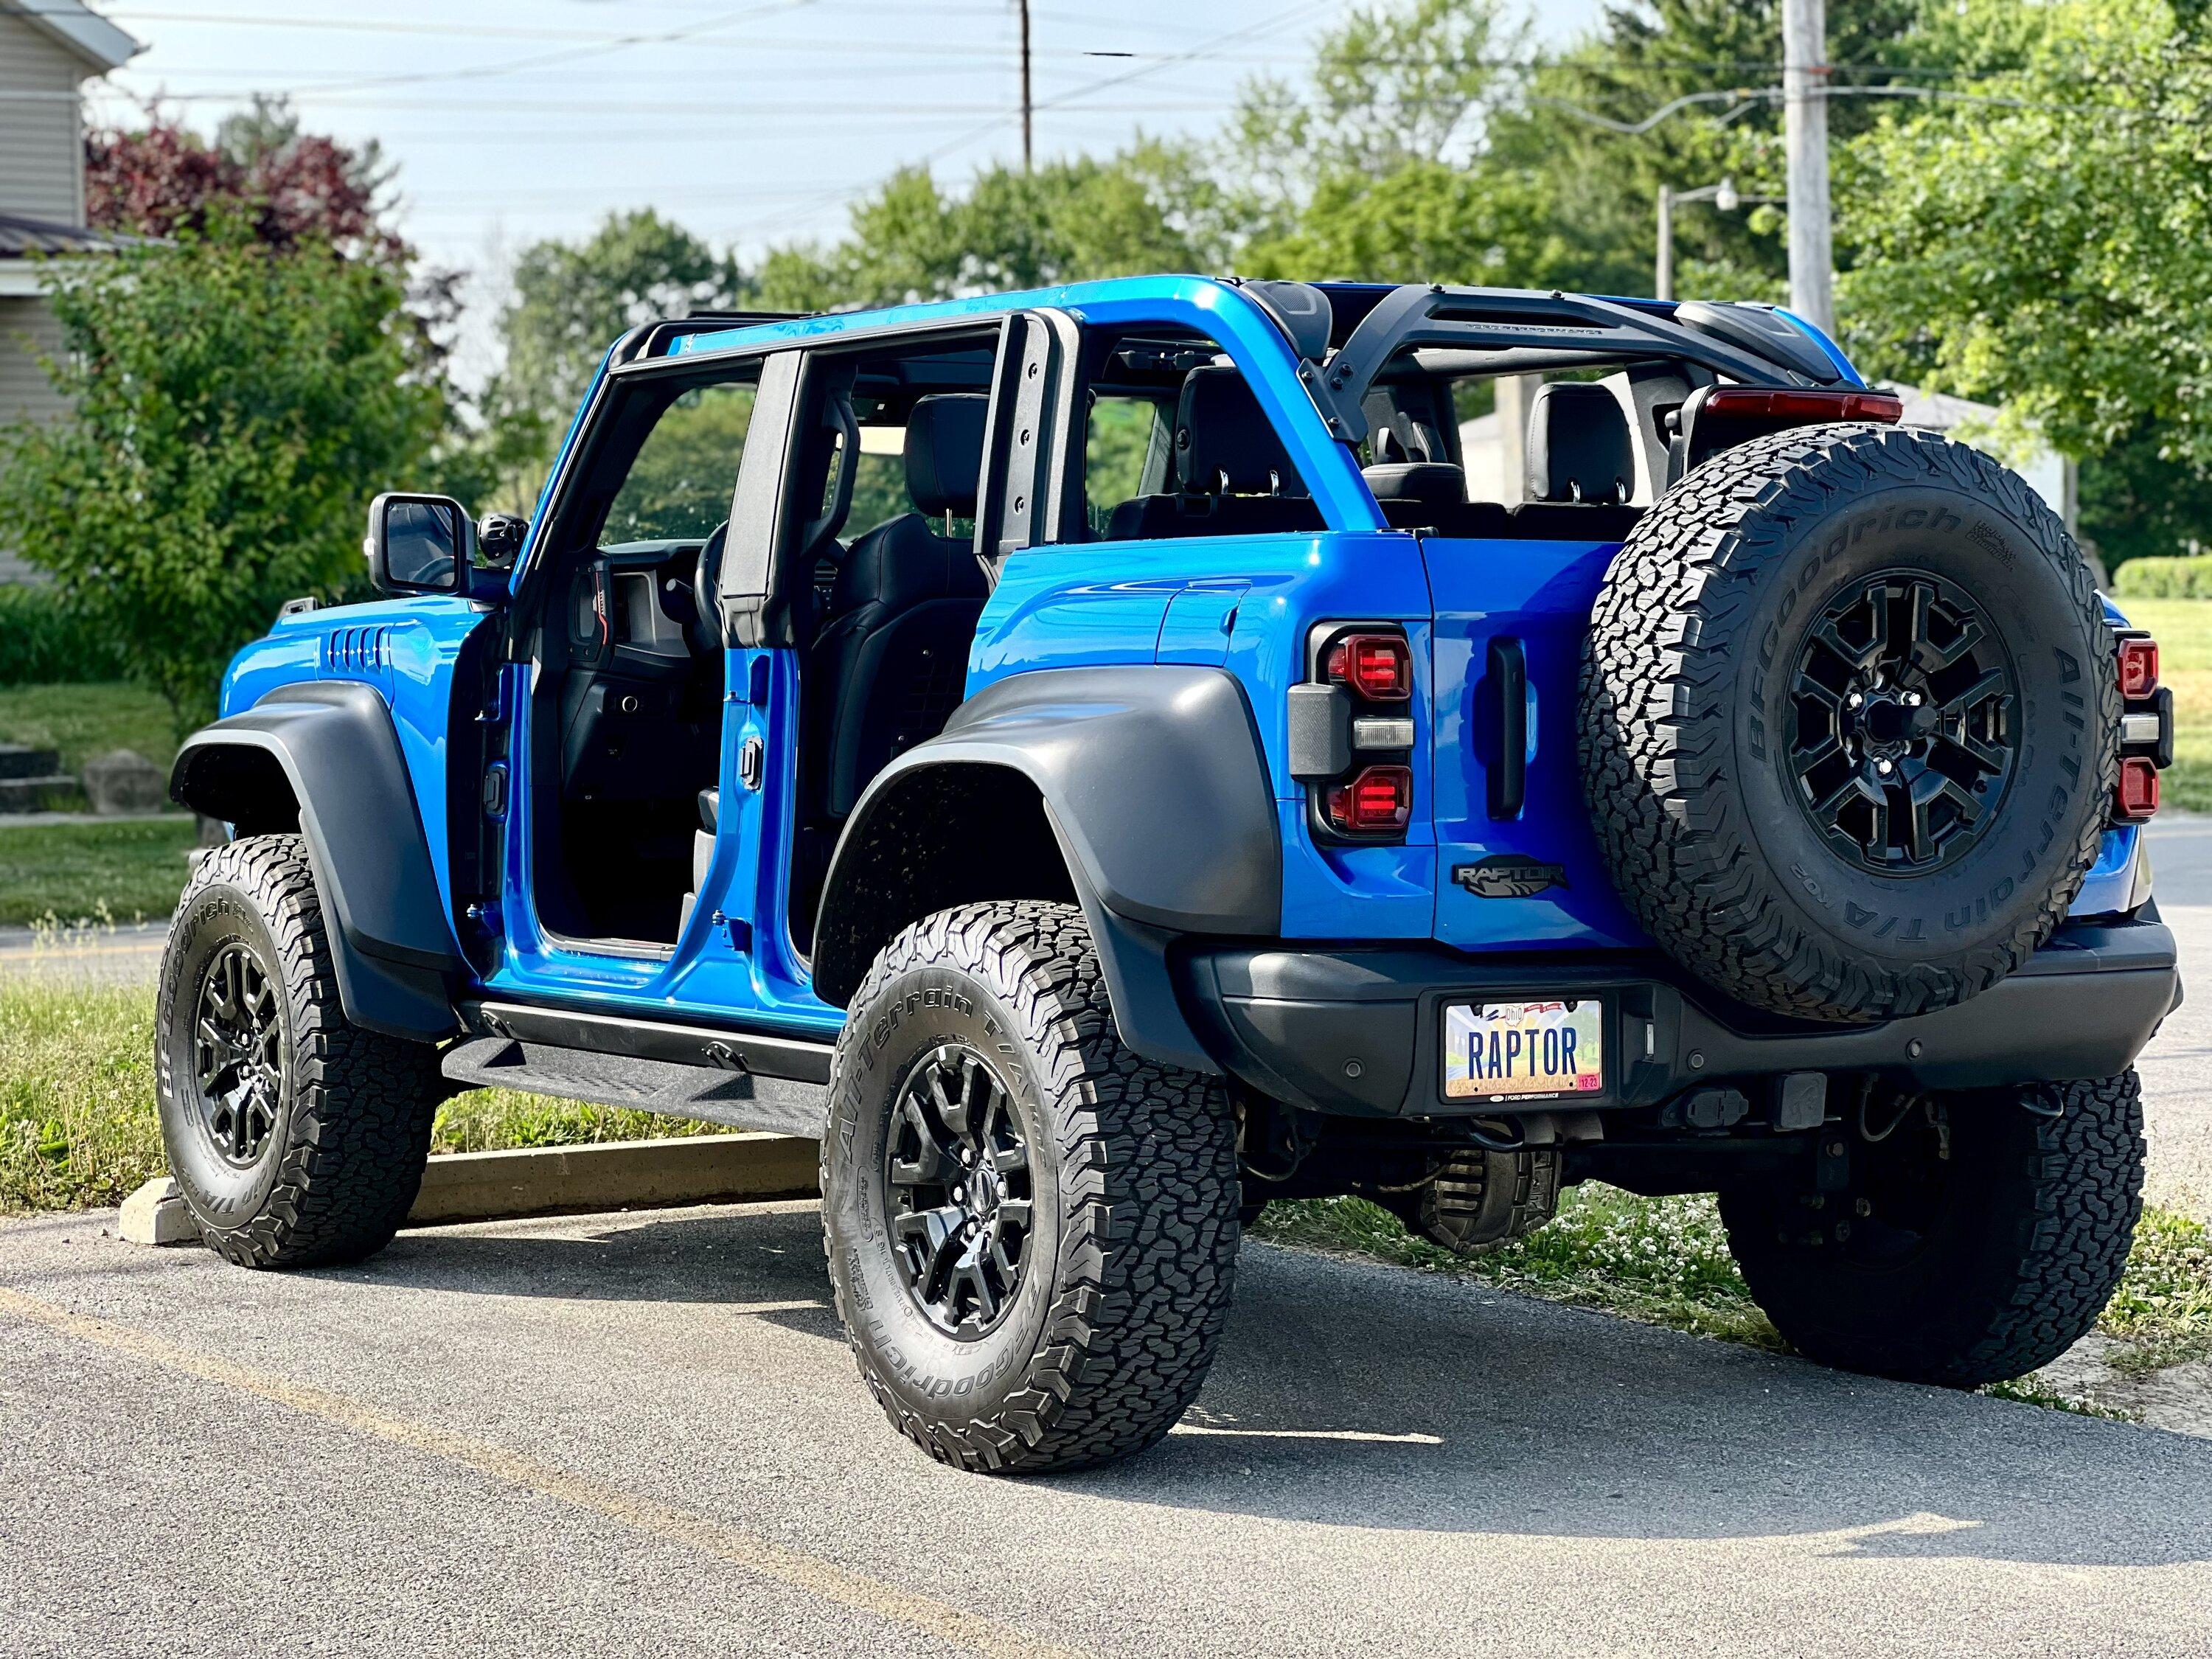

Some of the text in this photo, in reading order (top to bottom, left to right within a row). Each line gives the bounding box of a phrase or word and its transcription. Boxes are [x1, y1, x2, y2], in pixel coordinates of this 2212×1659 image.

[1750, 507, 1962, 761] BFGoodrich
[1458, 866, 1564, 886] RAPTOR
[160, 897, 230, 1099] BFGoodrich
[838, 985, 973, 1164] All-Terrain
[1468, 1026, 1577, 1080] RAPTOR
[868, 1265, 1042, 1400] BFGoodrich
